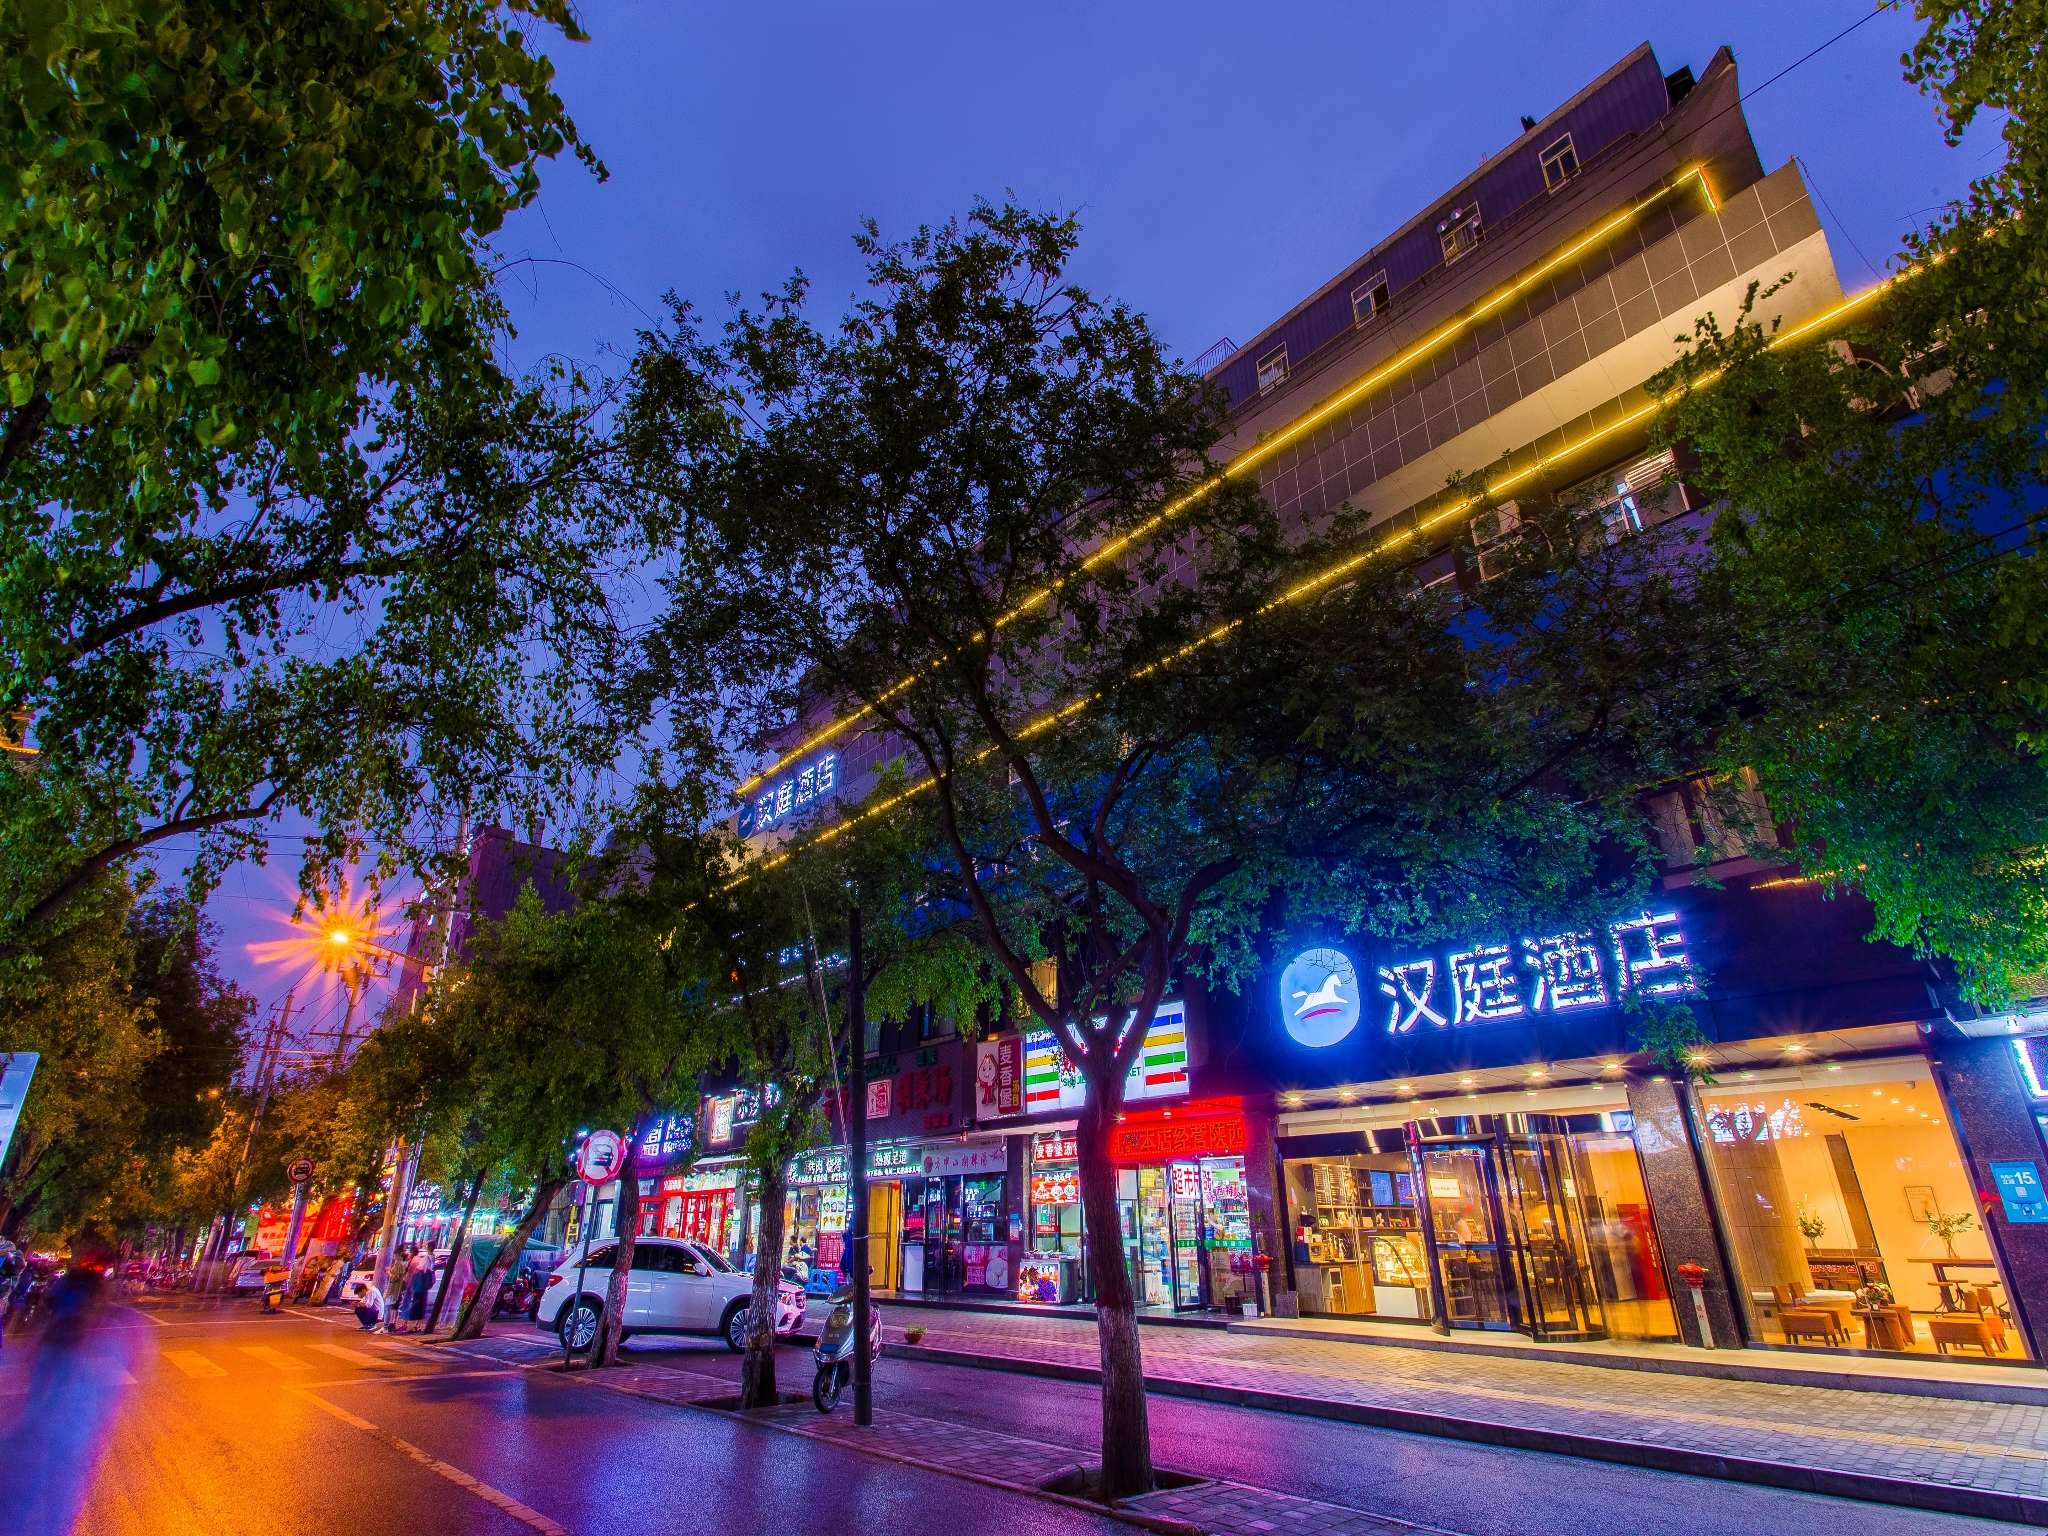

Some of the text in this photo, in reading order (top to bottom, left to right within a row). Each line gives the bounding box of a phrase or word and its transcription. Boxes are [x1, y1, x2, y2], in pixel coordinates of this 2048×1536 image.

[756, 754, 835, 830] 汉庭酒店
[1378, 911, 1697, 1034] 汉庭酒店
[1000, 1044, 1013, 1108] 麦香堡
[1172, 1168, 1193, 1195] 超市
